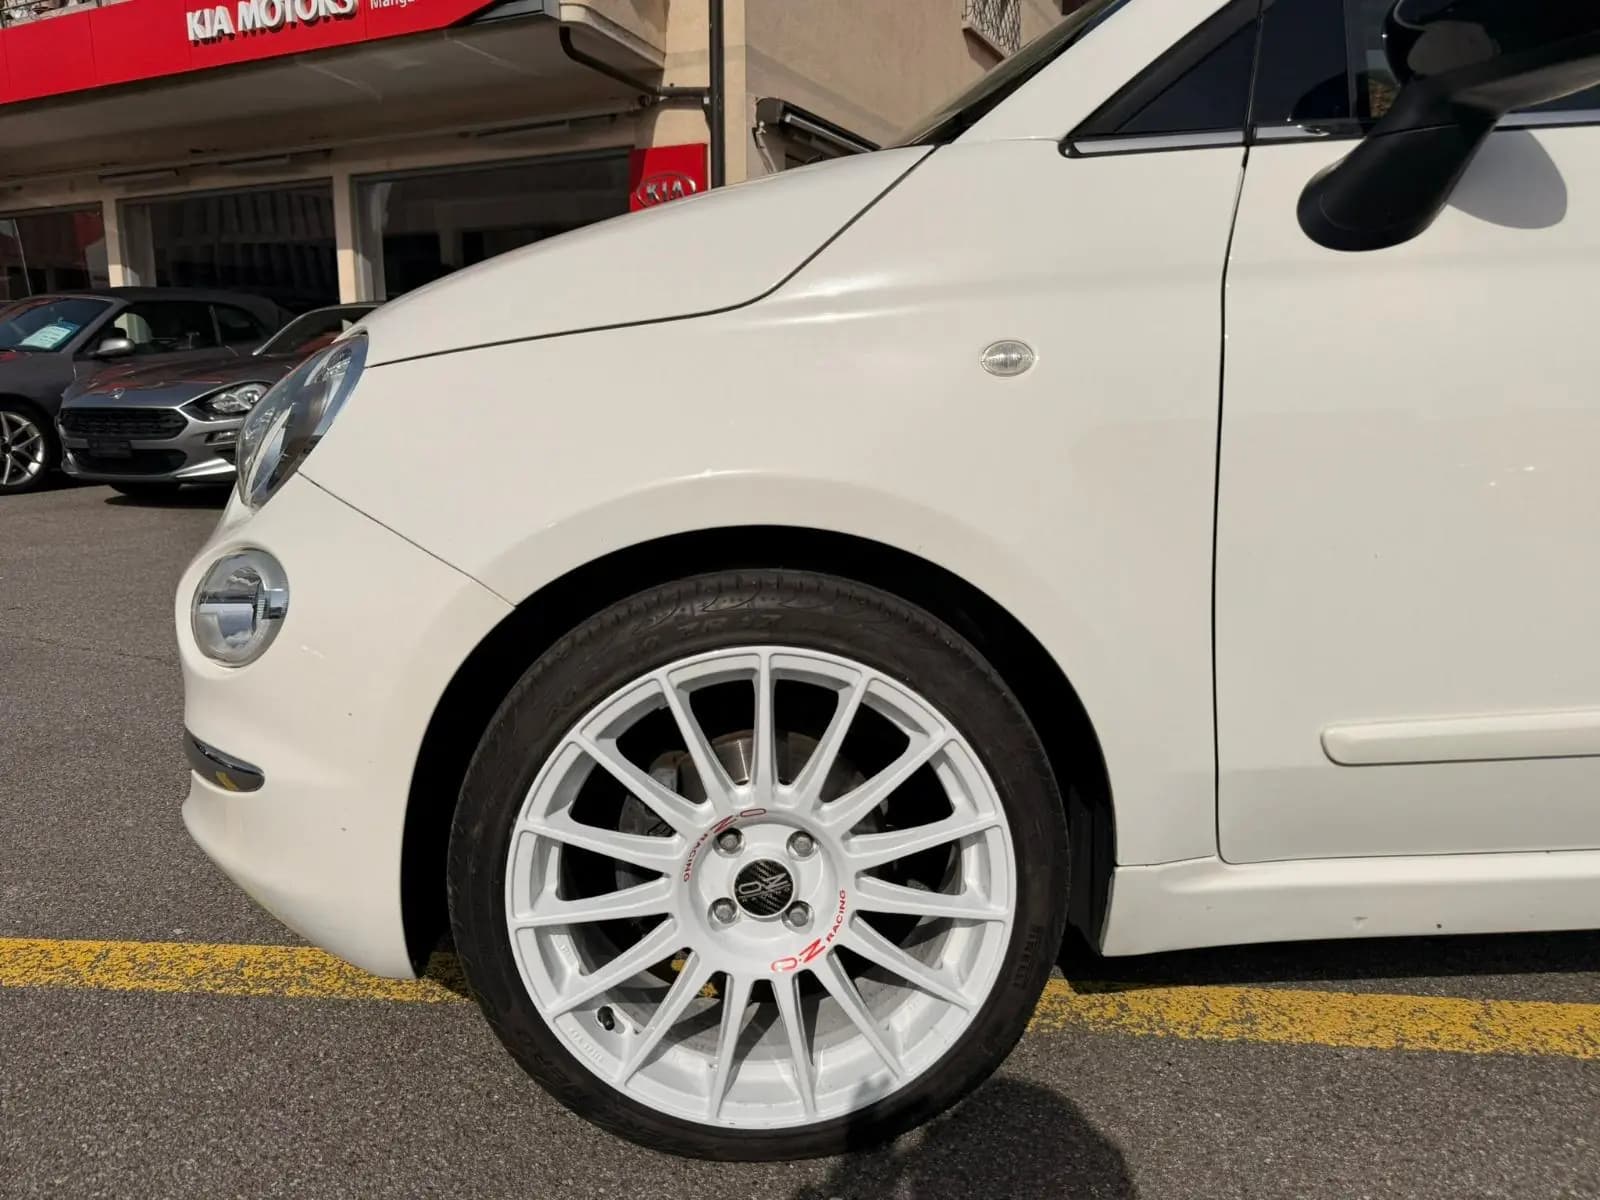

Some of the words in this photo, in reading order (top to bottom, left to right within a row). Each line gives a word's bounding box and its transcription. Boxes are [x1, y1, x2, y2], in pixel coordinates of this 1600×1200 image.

[186, 5, 236, 41] KIA
[646, 177, 685, 202] KIA
[825, 889, 847, 943] RACING
